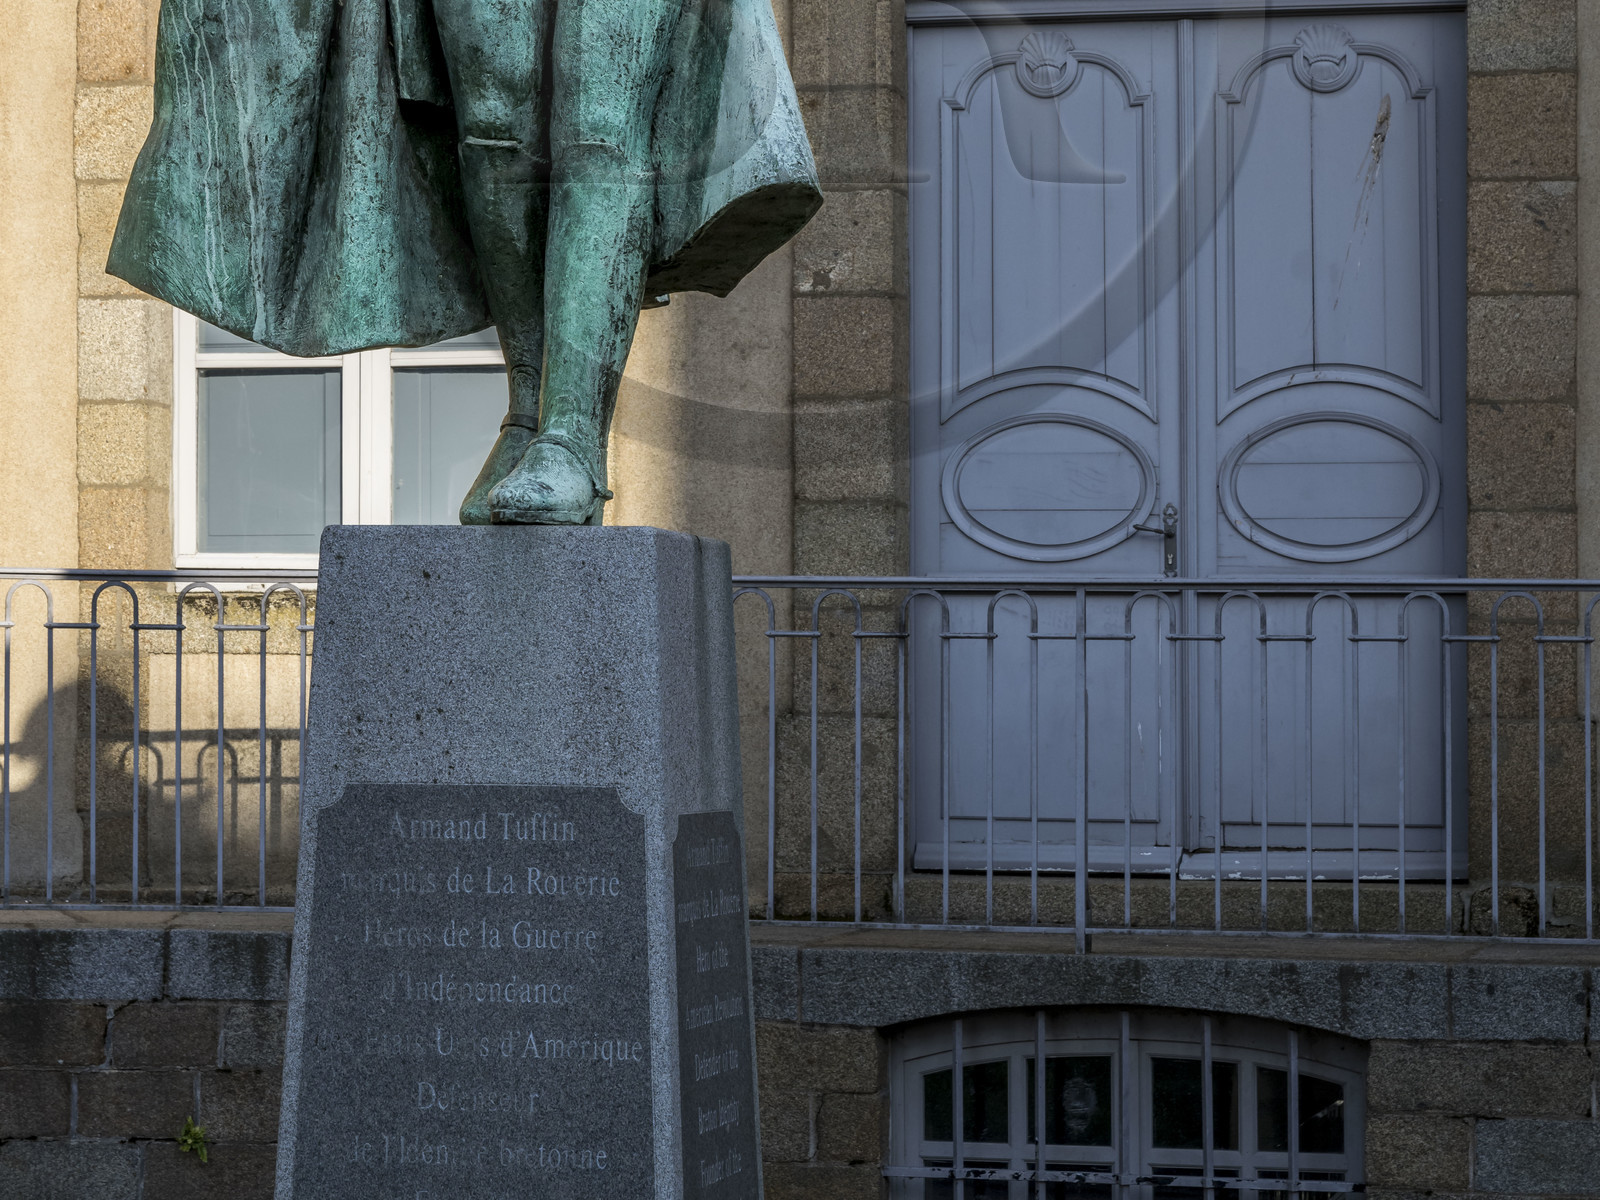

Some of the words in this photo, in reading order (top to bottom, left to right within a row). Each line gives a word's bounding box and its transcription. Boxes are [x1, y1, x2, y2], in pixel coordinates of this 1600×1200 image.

[390, 811, 487, 842] Armand
[498, 811, 576, 842] Tuffin
[447, 866, 474, 894] de
[486, 865, 516, 895] La
[443, 919, 470, 948] de
[480, 918, 501, 949] la
[512, 920, 597, 950] Guerre
